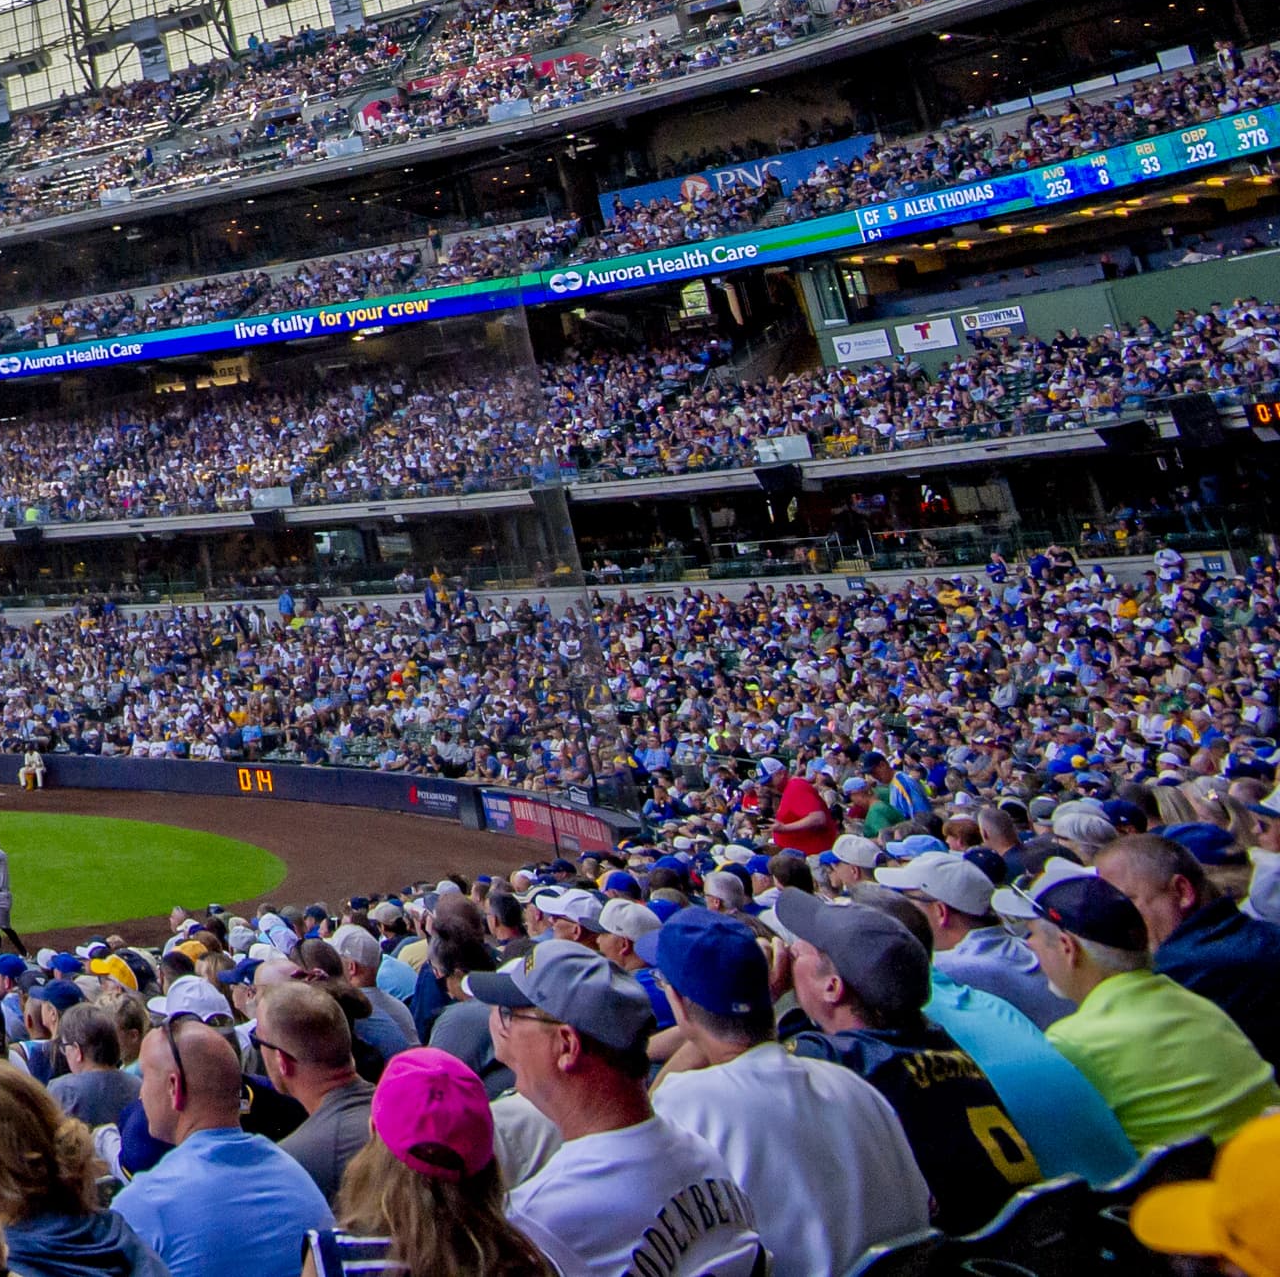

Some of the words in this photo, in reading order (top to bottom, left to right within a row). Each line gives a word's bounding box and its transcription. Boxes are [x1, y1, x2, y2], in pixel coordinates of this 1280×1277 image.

[1233, 115, 1259, 131] SLG
[1181, 129, 1208, 145] OBP
[1237, 129, 1270, 152] .378
[1136, 143, 1157, 157] RBI
[1186, 141, 1218, 164] .292
[1090, 155, 1108, 168] HR
[1141, 158, 1162, 174] 33
[711, 160, 789, 193] PNC
[1042, 167, 1066, 181] AVG
[1098, 169, 1110, 185] 8
[1045, 178, 1075, 199] .252
[864, 209, 881, 226] CF
[888, 206, 898, 221] 5
[905, 197, 937, 218] ALEK
[939, 184, 995, 209] THOMAS
[868, 228, 883, 240] 0-1
[586, 267, 645, 289] Aurora
[649, 252, 710, 277] Health
[712, 244, 757, 265] Care
[234, 321, 268, 340] live
[272, 313, 315, 338] fully
[319, 309, 342, 327] for
[345, 305, 384, 328] your
[388, 299, 429, 318] crew
[23, 355, 65, 372] Aurora
[66, 347, 109, 366] Health
[110, 343, 142, 360] Care
